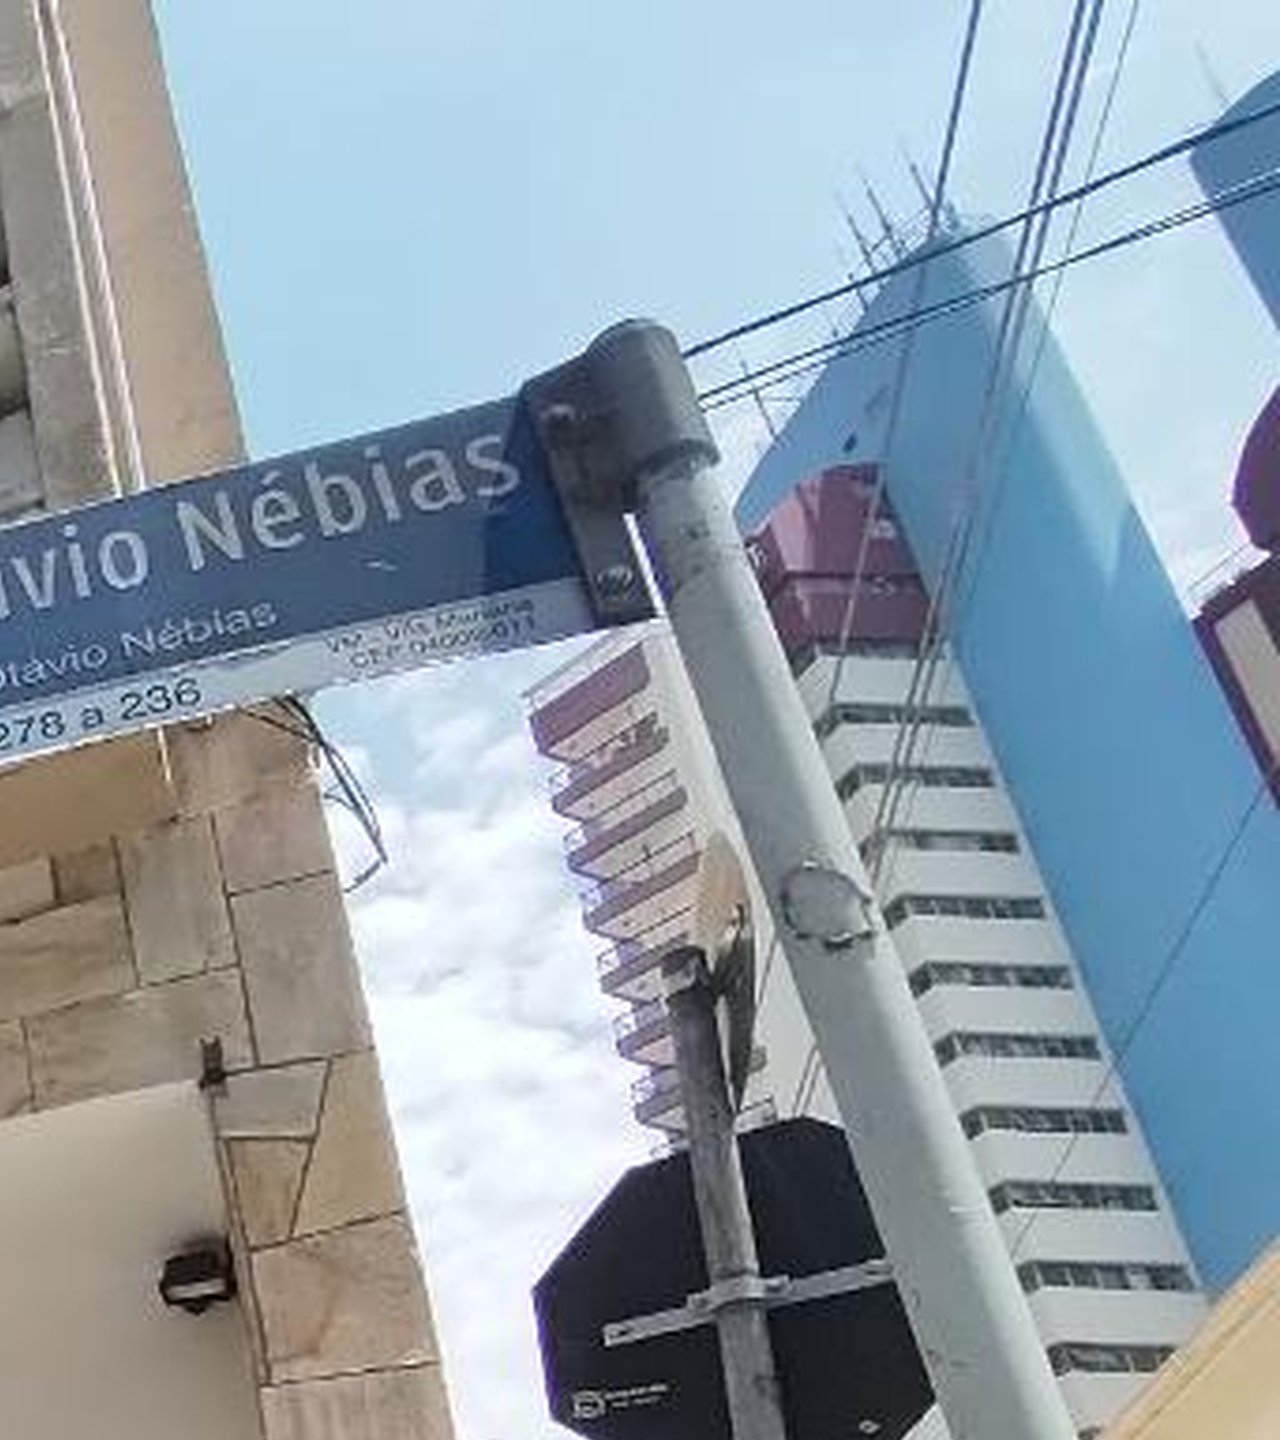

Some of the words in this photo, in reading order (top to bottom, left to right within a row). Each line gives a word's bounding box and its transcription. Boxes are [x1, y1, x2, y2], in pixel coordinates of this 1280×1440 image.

[177, 434, 520, 572] Nébias
[80, 707, 104, 729] a
[120, 677, 202, 721] 236
